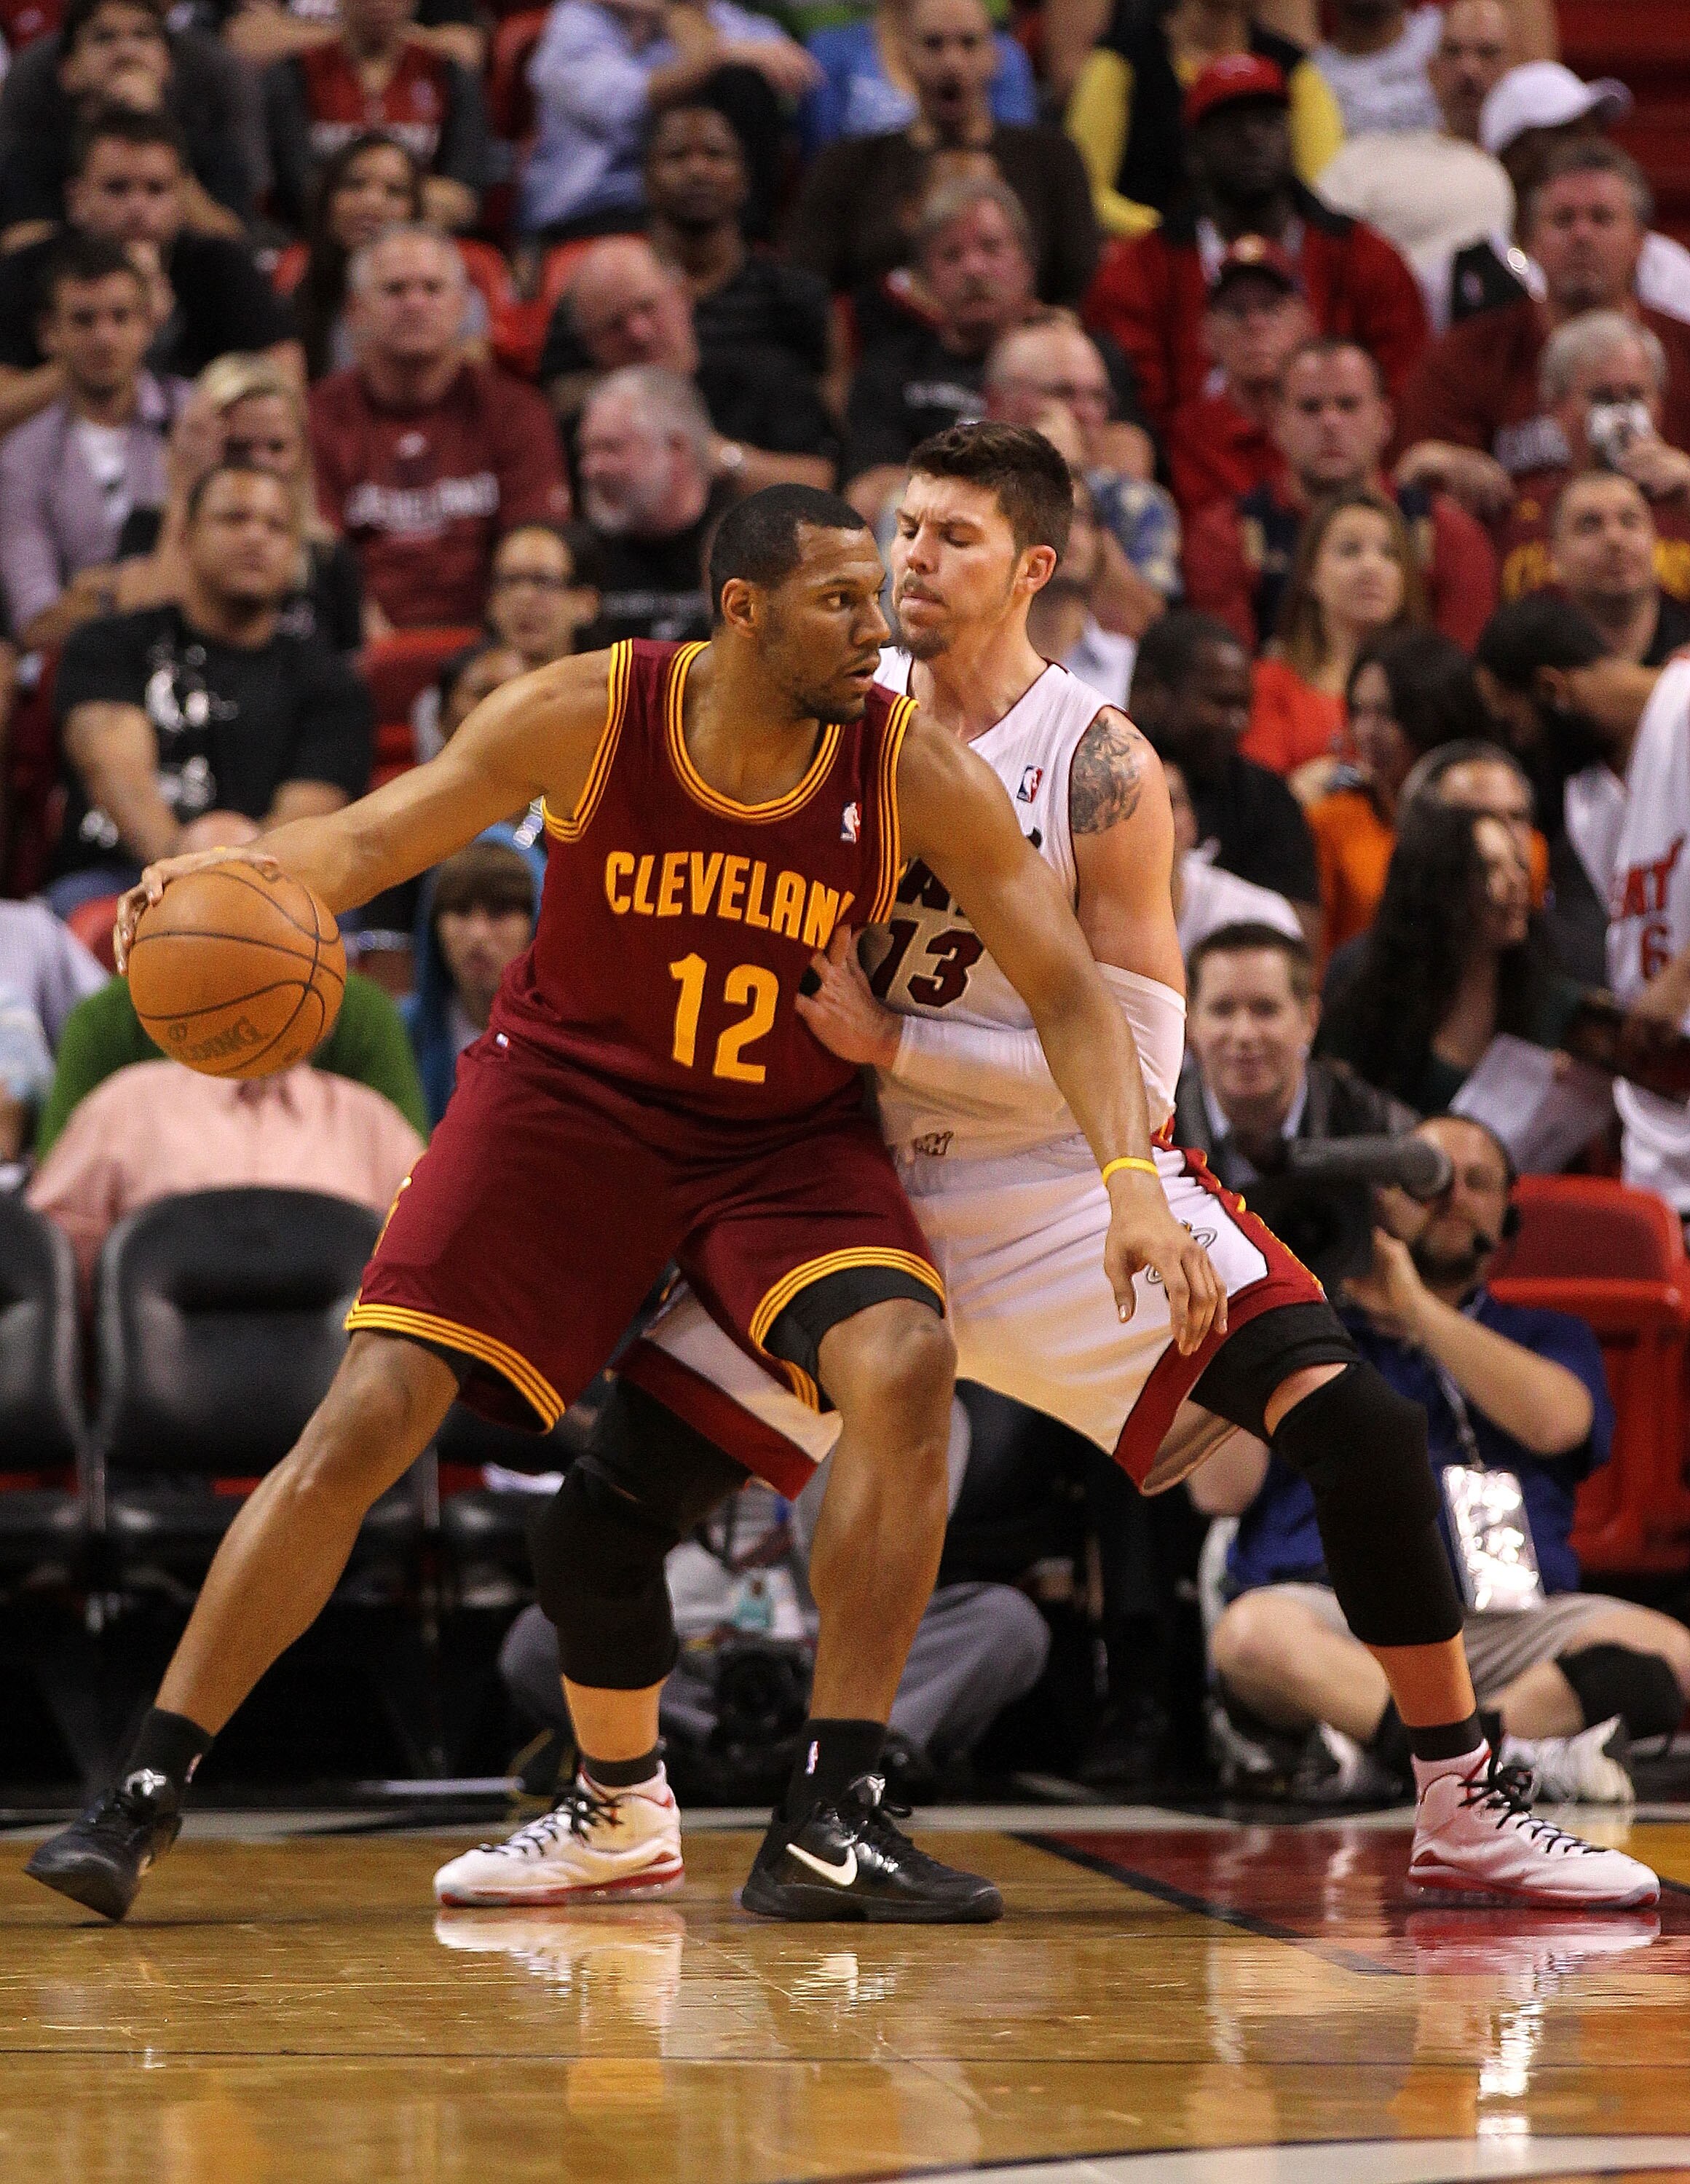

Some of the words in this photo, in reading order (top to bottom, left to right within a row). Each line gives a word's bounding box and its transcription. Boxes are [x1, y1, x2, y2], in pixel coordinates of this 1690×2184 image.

[605, 850, 855, 949] CLEVELAN
[873, 918, 984, 1008] 13
[1640, 922, 1669, 980] 6
[669, 952, 779, 1085] 12
